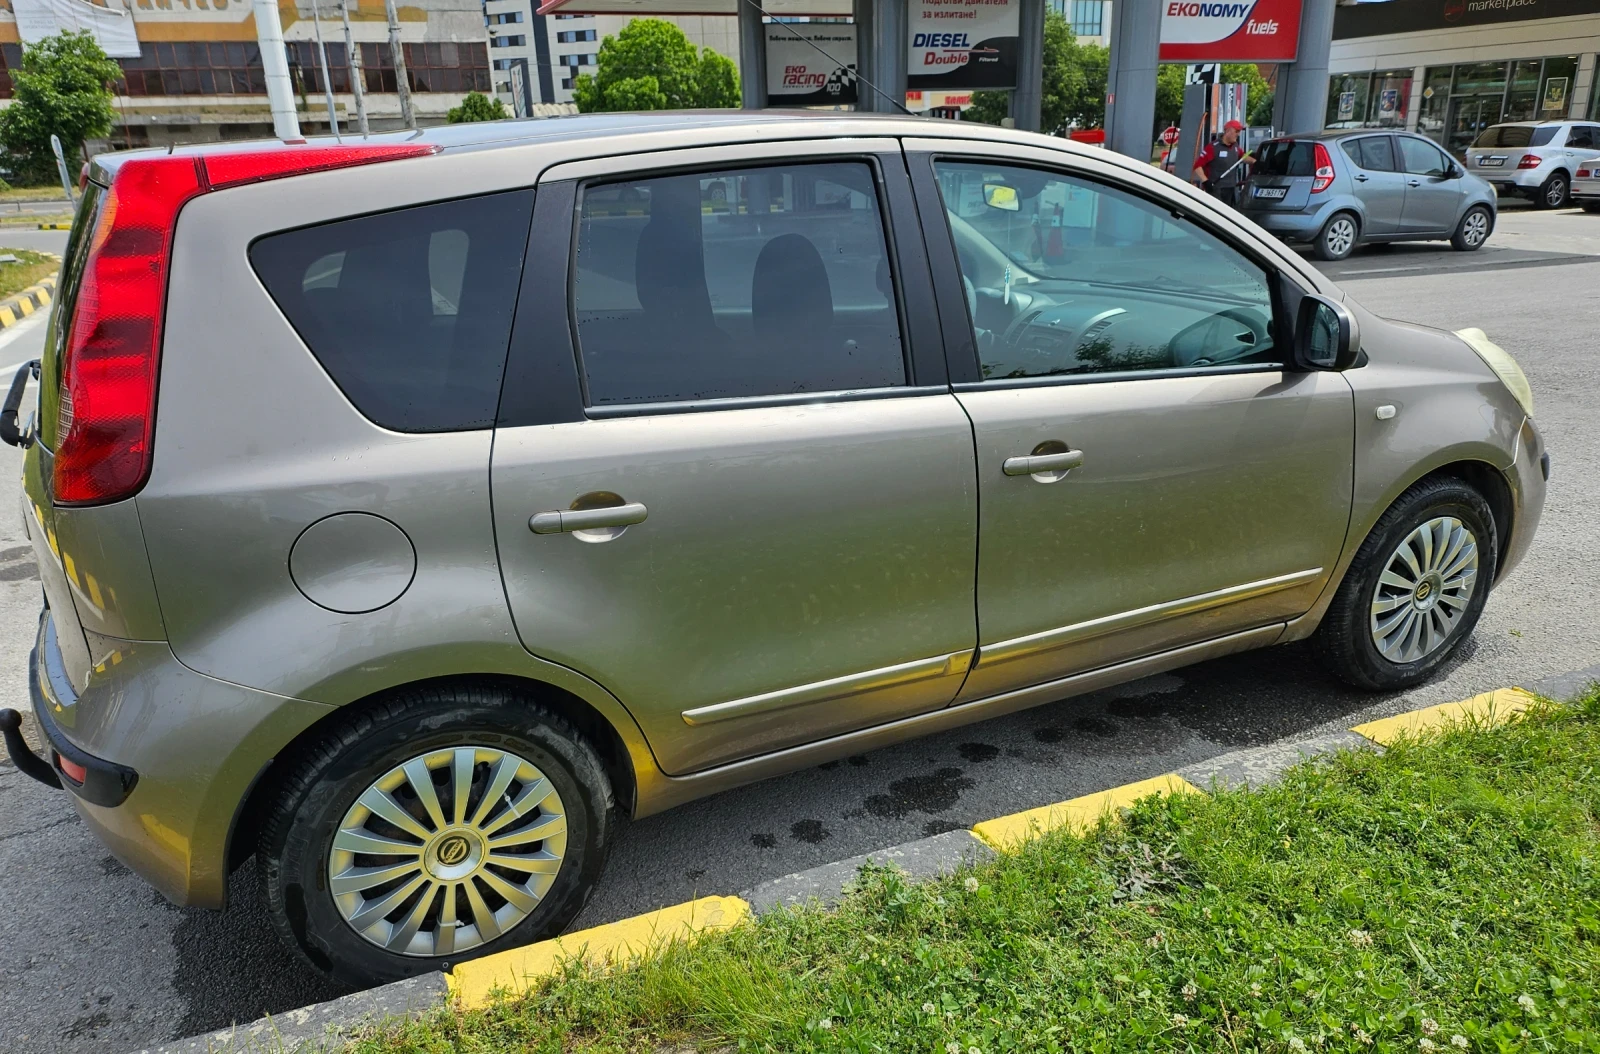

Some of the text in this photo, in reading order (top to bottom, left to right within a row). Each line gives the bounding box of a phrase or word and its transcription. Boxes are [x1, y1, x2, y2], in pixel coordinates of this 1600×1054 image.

[922, 9, 977, 19] за излитане!
[1166, 2, 1250, 18] EKONOMY
[1246, 19, 1279, 35] fuels
[912, 33, 970, 48] DIESEL
[924, 51, 968, 66] Double
[785, 65, 807, 74] EKO
[783, 73, 827, 88] racing
[826, 83, 842, 92] 100
